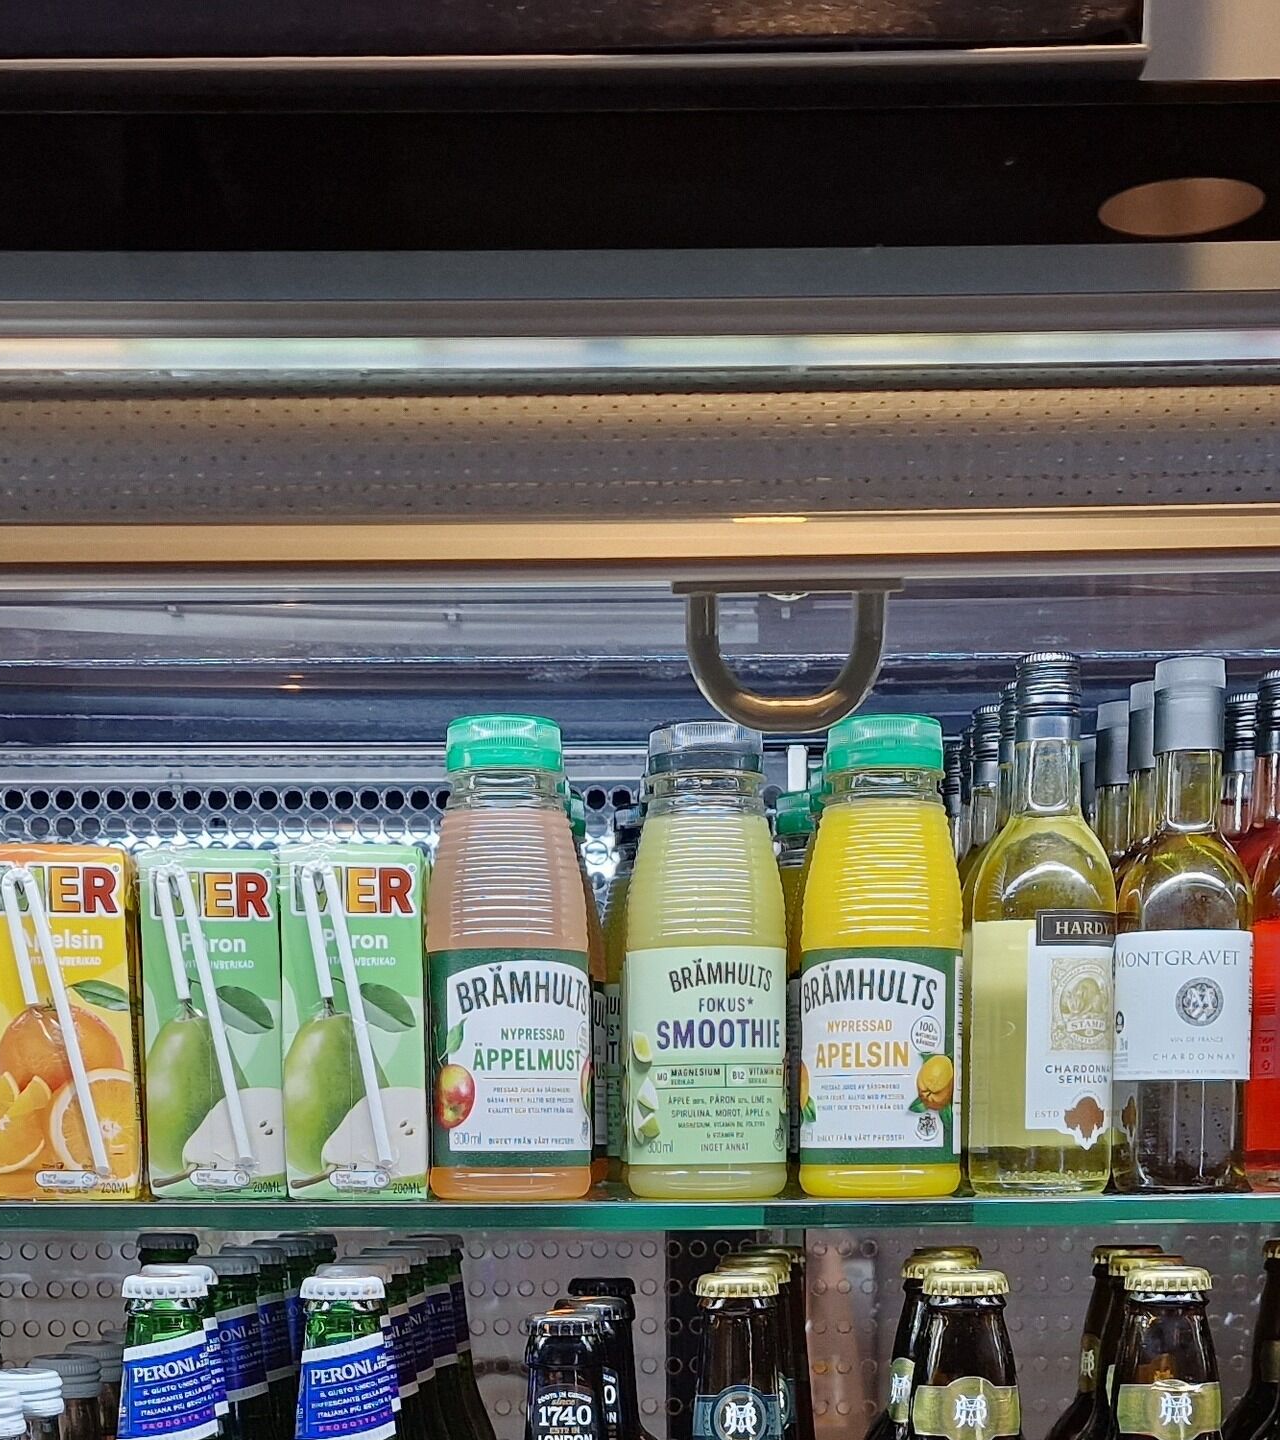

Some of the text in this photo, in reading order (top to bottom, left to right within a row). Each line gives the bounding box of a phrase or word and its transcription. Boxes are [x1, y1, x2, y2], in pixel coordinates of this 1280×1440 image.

[322, 930, 389, 951] Pron
[1117, 950, 1240, 968] MONTGRAVET
[669, 958, 773, 993] BRÄMHULTS
[456, 965, 588, 1015] BRÄMHULTS
[803, 964, 938, 1014] BRÄMHULTS
[501, 1028, 565, 1041] NYPRESSAD
[657, 1019, 780, 1050] SMOOTHIE
[827, 1020, 893, 1033] NYPRESSAD
[1071, 1019, 1105, 1030] STAMP
[473, 1042, 581, 1072] ÄPPELMUST
[815, 1041, 909, 1069] APELSIN
[1153, 1053, 1236, 1061] CHARDONNAY
[1058, 1074, 1108, 1084] SEMILLON
[1034, 1110, 1060, 1118] ESTD
[133, 1358, 197, 1384] PERONI
[310, 1361, 372, 1386] PERONI
[539, 1405, 592, 1427] 1740
